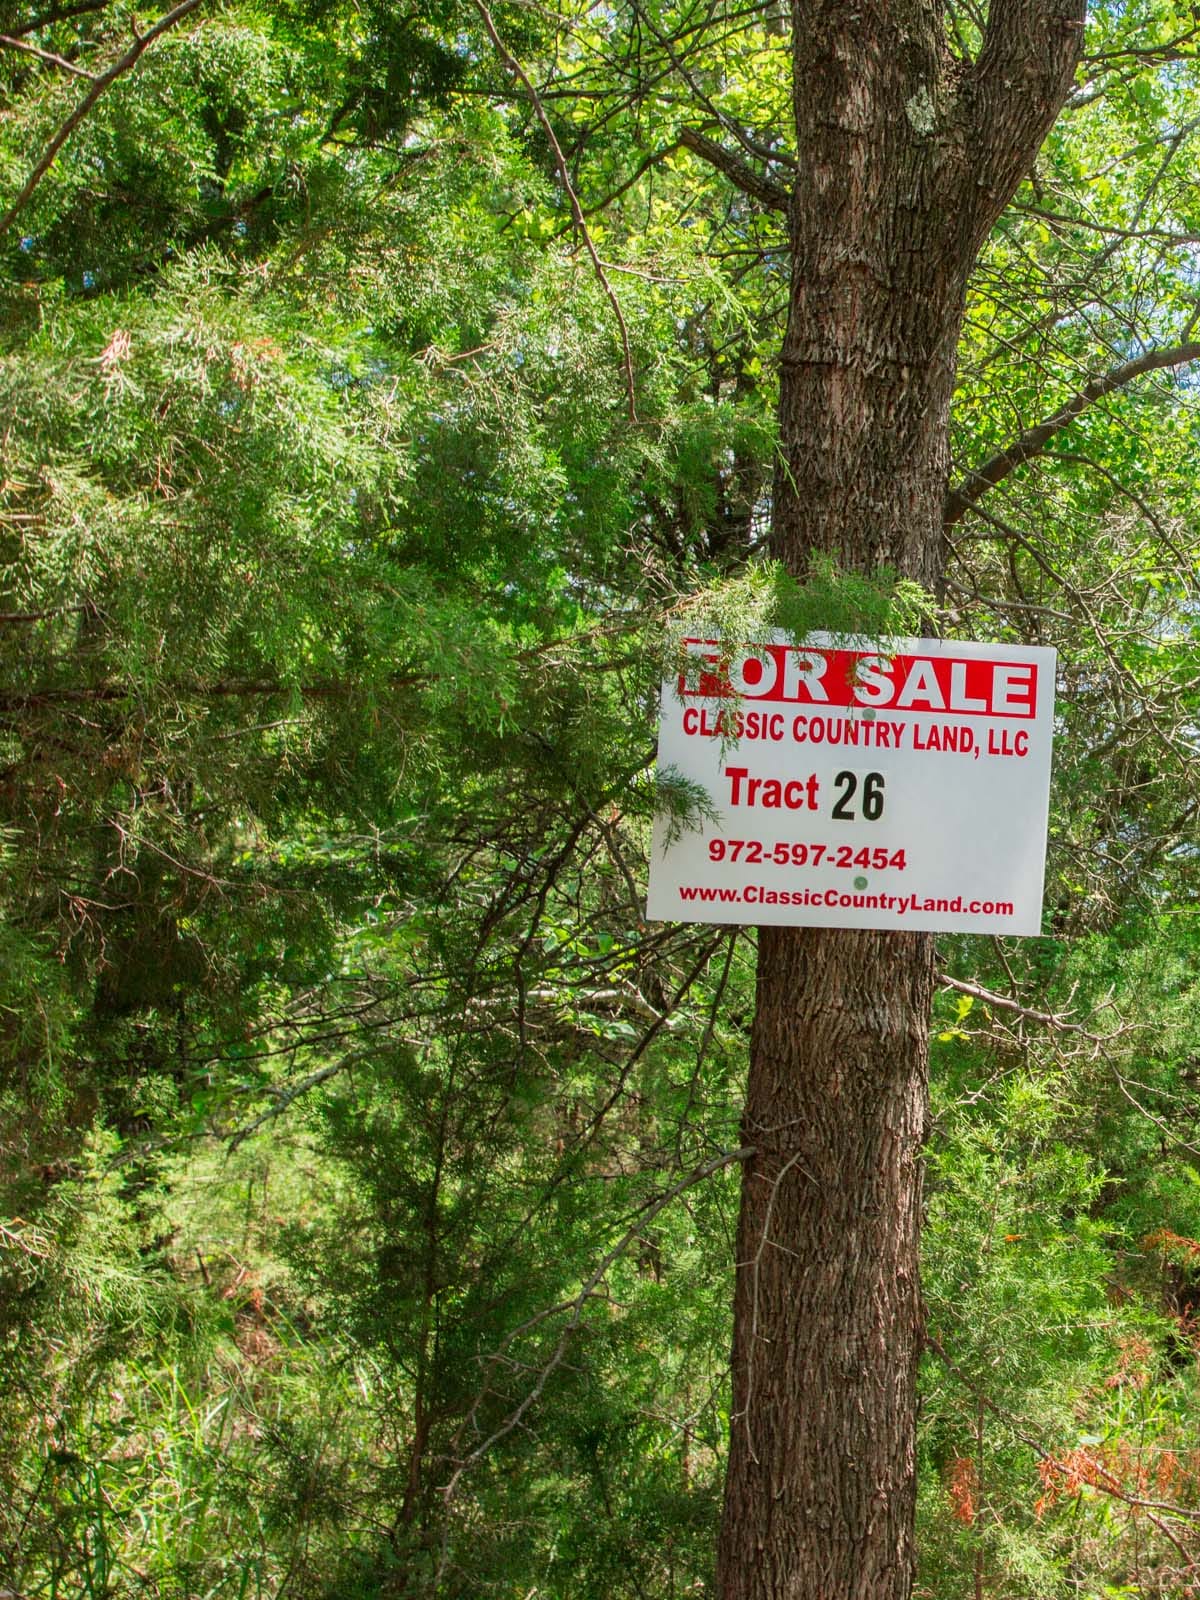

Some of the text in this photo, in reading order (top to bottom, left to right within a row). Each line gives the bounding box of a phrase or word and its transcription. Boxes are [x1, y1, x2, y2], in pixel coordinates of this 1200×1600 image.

[684, 642, 1032, 715] FOR SALE
[683, 708, 1029, 759] CLASSIC COUNTRY LAND, LLC
[725, 767, 885, 821] Tract 26
[708, 839, 907, 871] 972-597-2454
[679, 886, 1014, 915] www.ClassicCountryLand.com
